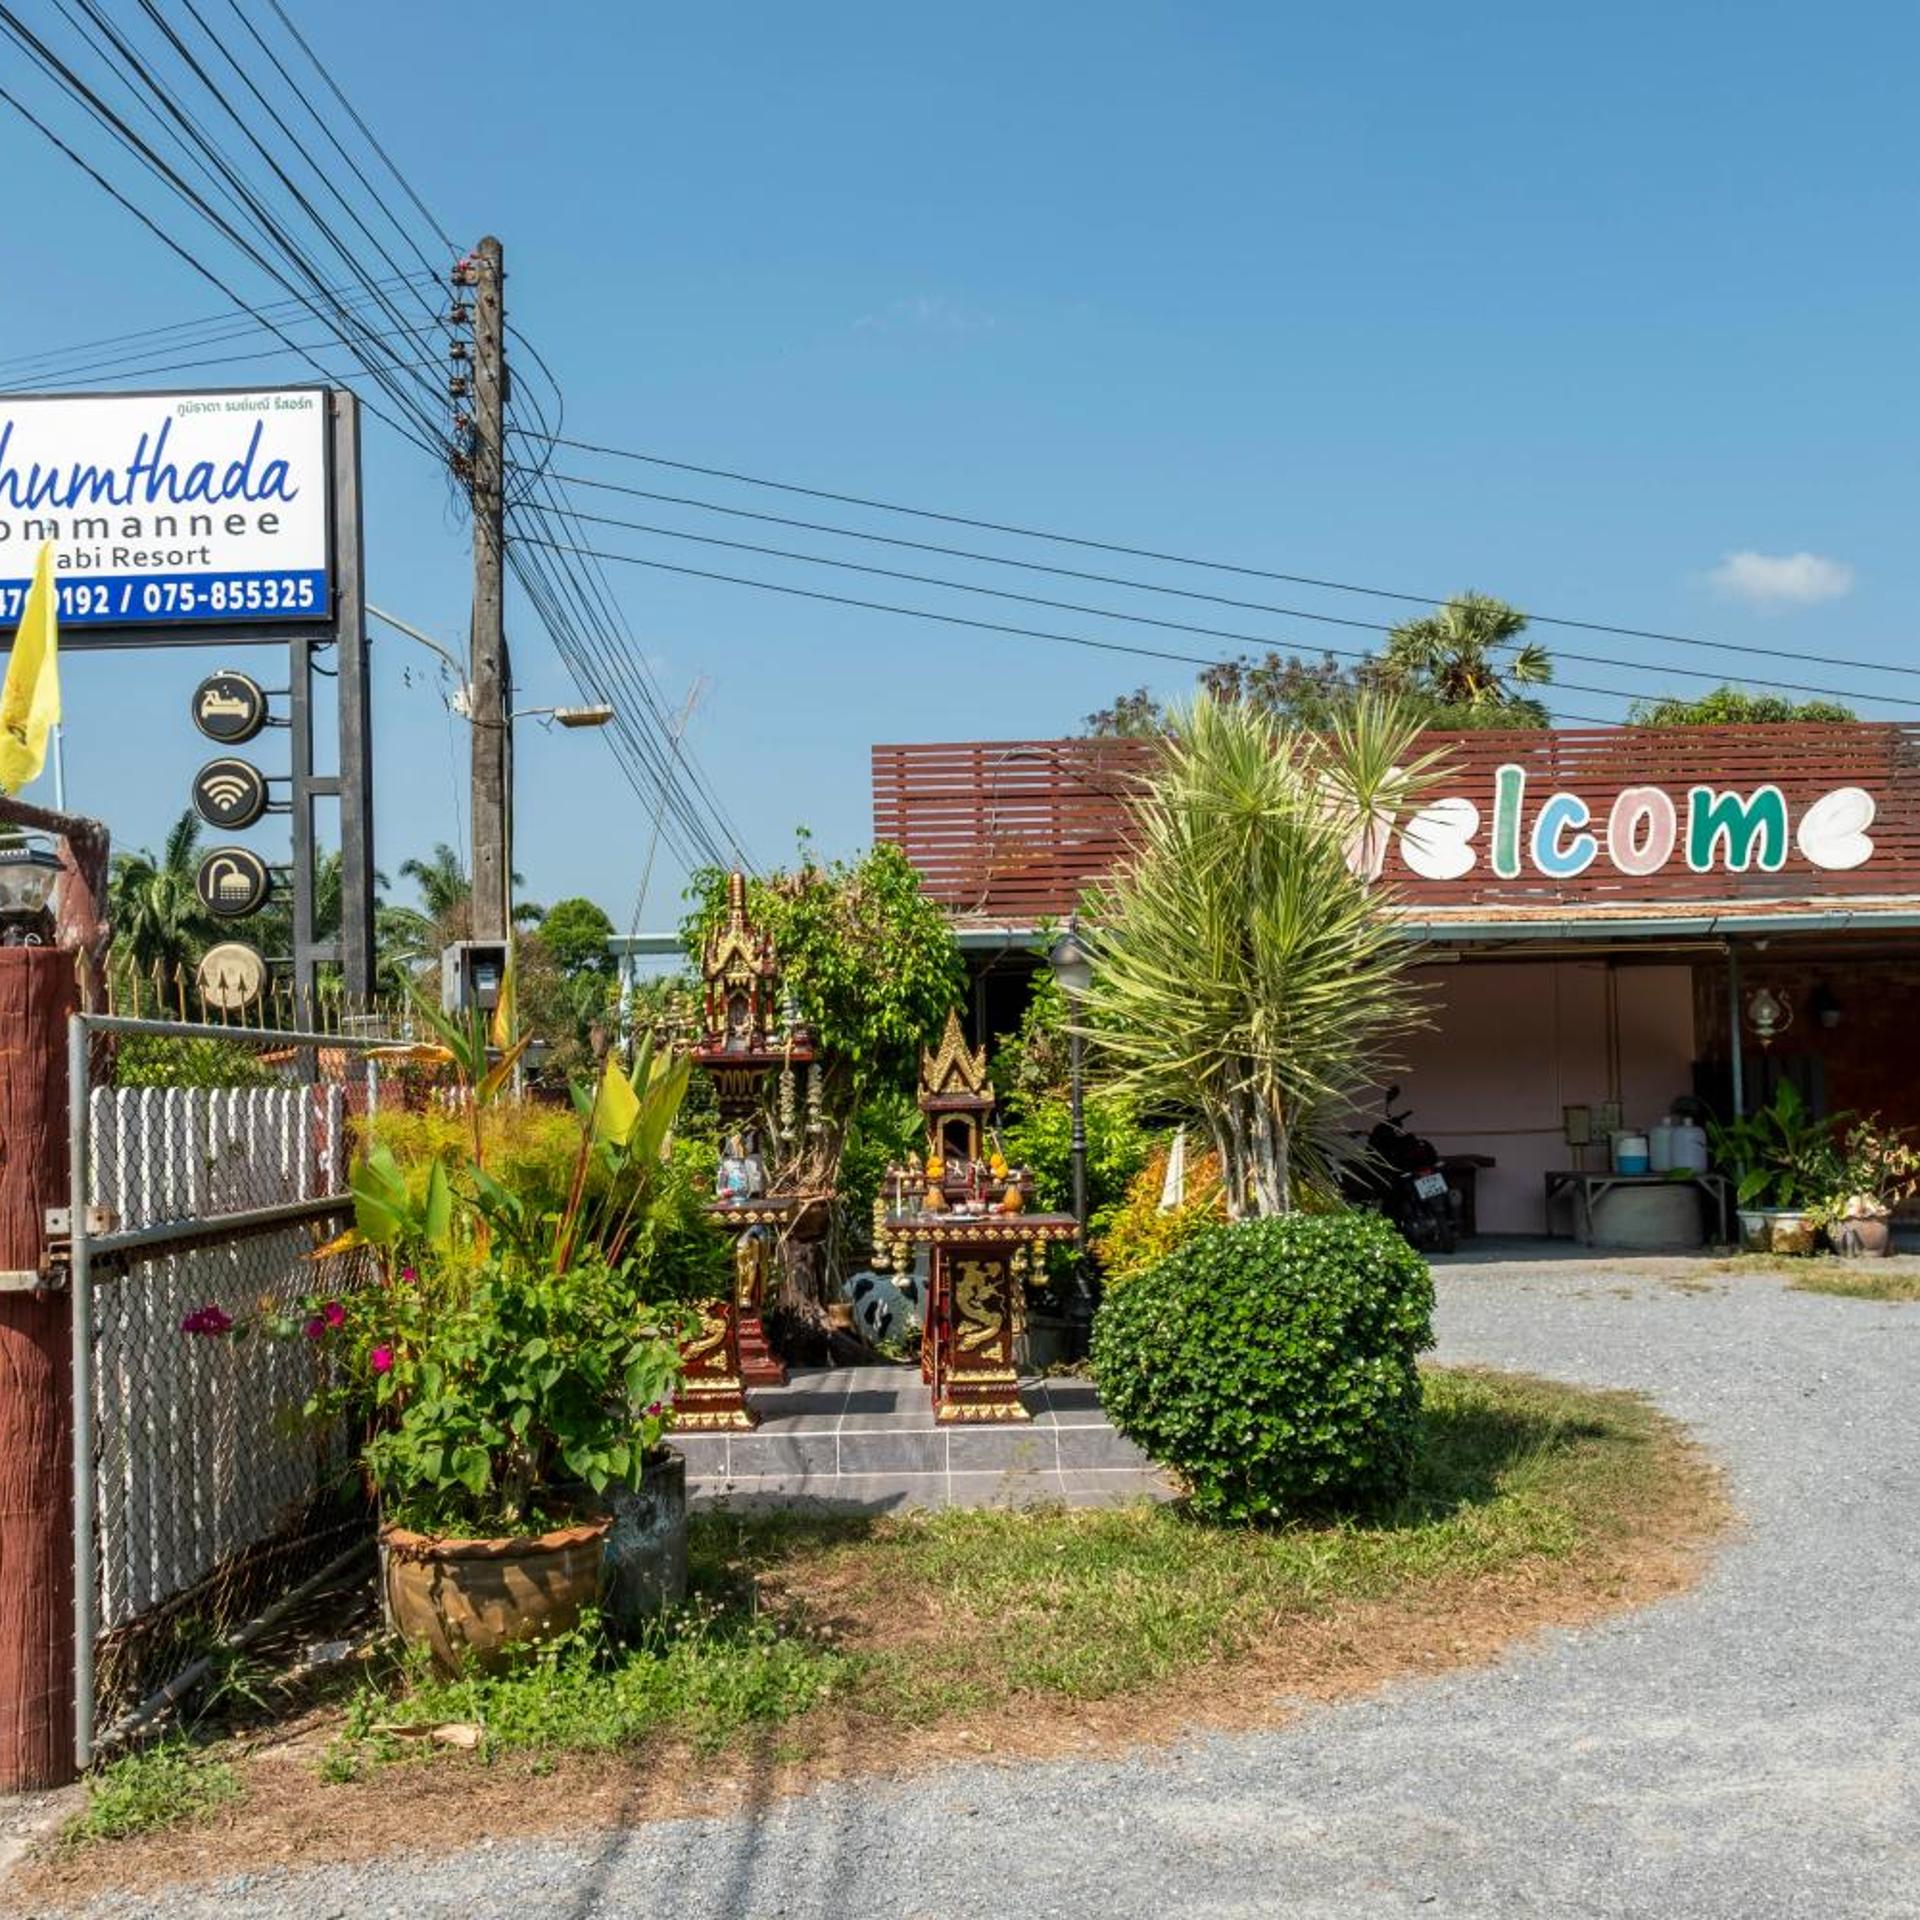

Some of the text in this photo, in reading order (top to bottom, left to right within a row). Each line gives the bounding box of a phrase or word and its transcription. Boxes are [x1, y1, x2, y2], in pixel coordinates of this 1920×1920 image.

[112, 546, 211, 568] Resort
[120, 583, 132, 613] /
[143, 578, 314, 612] 075-855325
